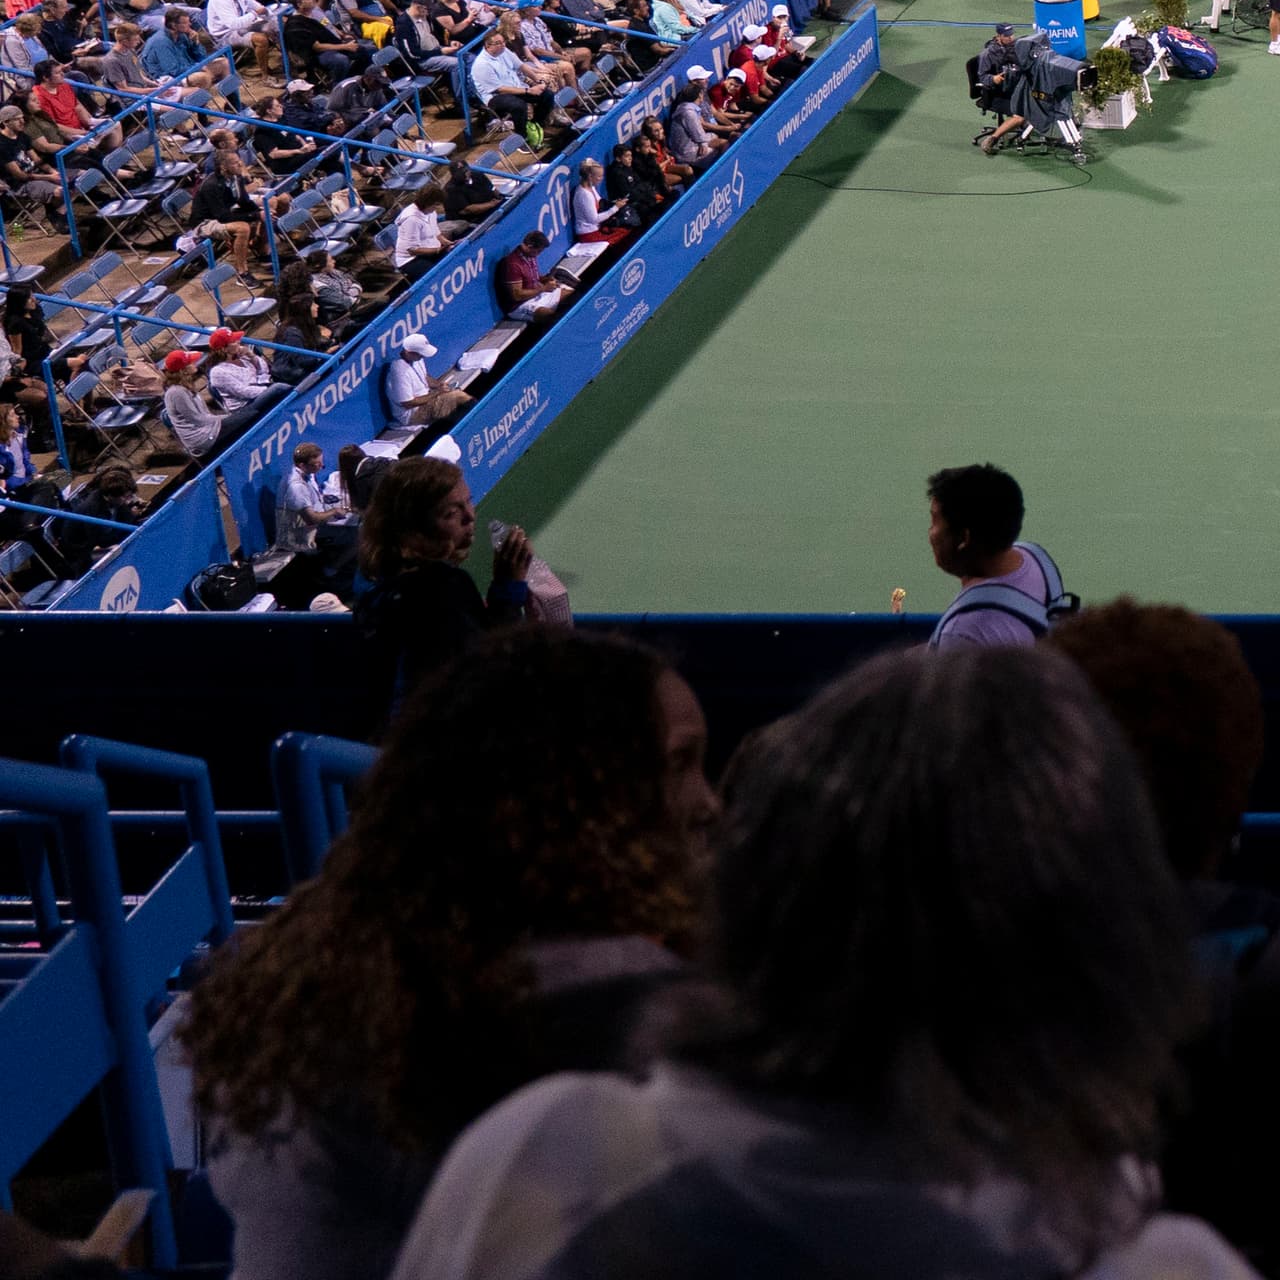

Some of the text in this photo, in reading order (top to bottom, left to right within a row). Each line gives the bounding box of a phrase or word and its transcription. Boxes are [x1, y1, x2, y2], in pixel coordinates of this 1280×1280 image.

[615, 75, 676, 145] GEICO
[776, 35, 874, 146] www.citiopentennis.com
[537, 170, 571, 245] citi
[249, 421, 293, 483] ATP
[296, 345, 376, 436] WORLD
[482, 380, 541, 451] Insperity
